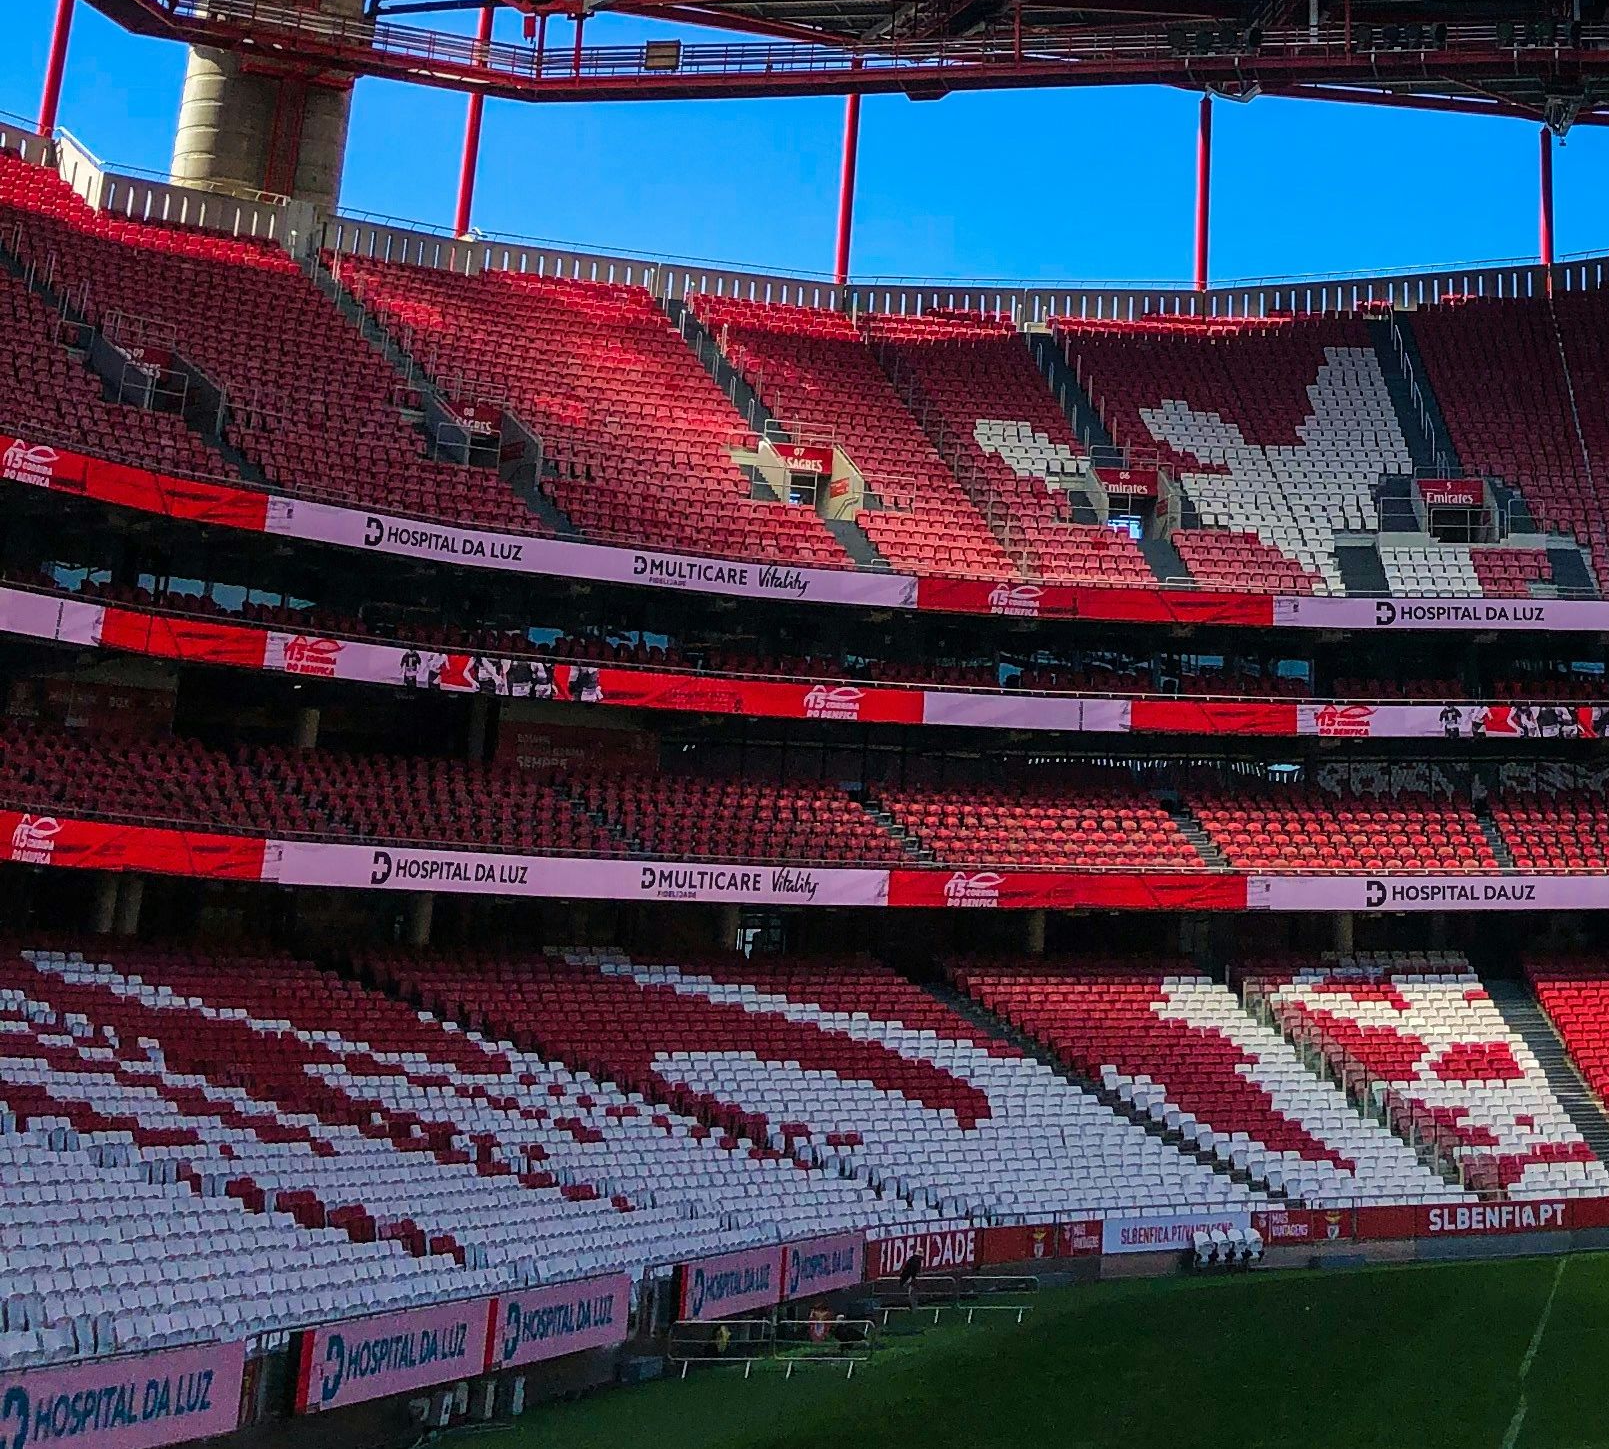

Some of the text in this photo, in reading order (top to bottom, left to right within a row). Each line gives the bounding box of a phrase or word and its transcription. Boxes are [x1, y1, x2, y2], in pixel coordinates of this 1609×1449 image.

[793, 447, 805, 457] 07
[787, 456, 822, 472] SAGRES
[1119, 471, 1130, 480] 06
[1103, 481, 1148, 495] Emirates
[1446, 482, 1451, 491] 5
[1426, 491, 1473, 505] Emirates
[387, 526, 523, 561] HOSPITAL DA LUZ
[650, 559, 809, 594] MULTICARE Vitality
[993, 593, 1007, 606] 15
[1400, 606, 1544, 621] HOSPITAL DA LUZ
[1320, 712, 1335, 726] 15
[395, 859, 528, 884] HOSPITAL DA LUZ
[658, 867, 819, 900] MULTICARE Vitality
[949, 881, 964, 895] 15
[1392, 885, 1476, 900] HOSPITAL
[1484, 885, 1508, 900] DA
[522, 1296, 614, 1344] HOSPITAL DA LUZ
[345, 1334, 467, 1379] HOSPITAL DA LUZ
[33, 1369, 214, 1437] HOSPITAL DA LUZ
